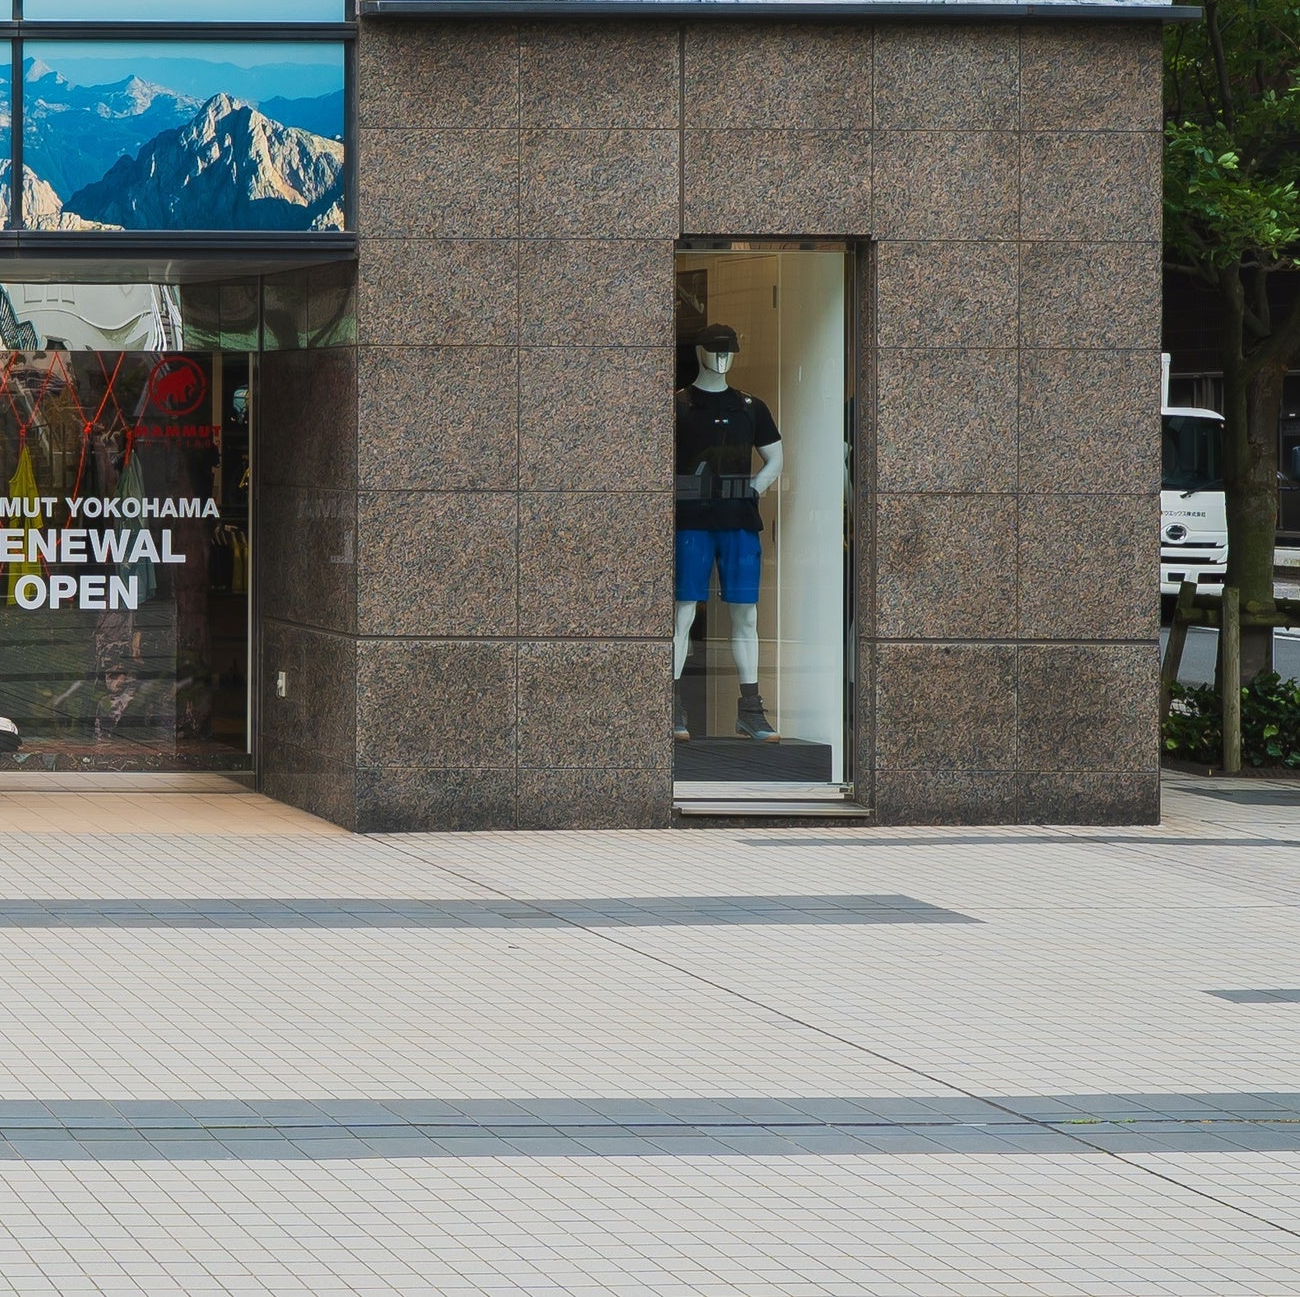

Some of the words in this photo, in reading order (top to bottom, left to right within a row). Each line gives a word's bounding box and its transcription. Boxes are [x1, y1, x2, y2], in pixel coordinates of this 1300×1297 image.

[135, 425, 221, 437] MAMMUT
[65, 497, 220, 518] YOKOHAMA
[14, 574, 138, 610] OPEN
